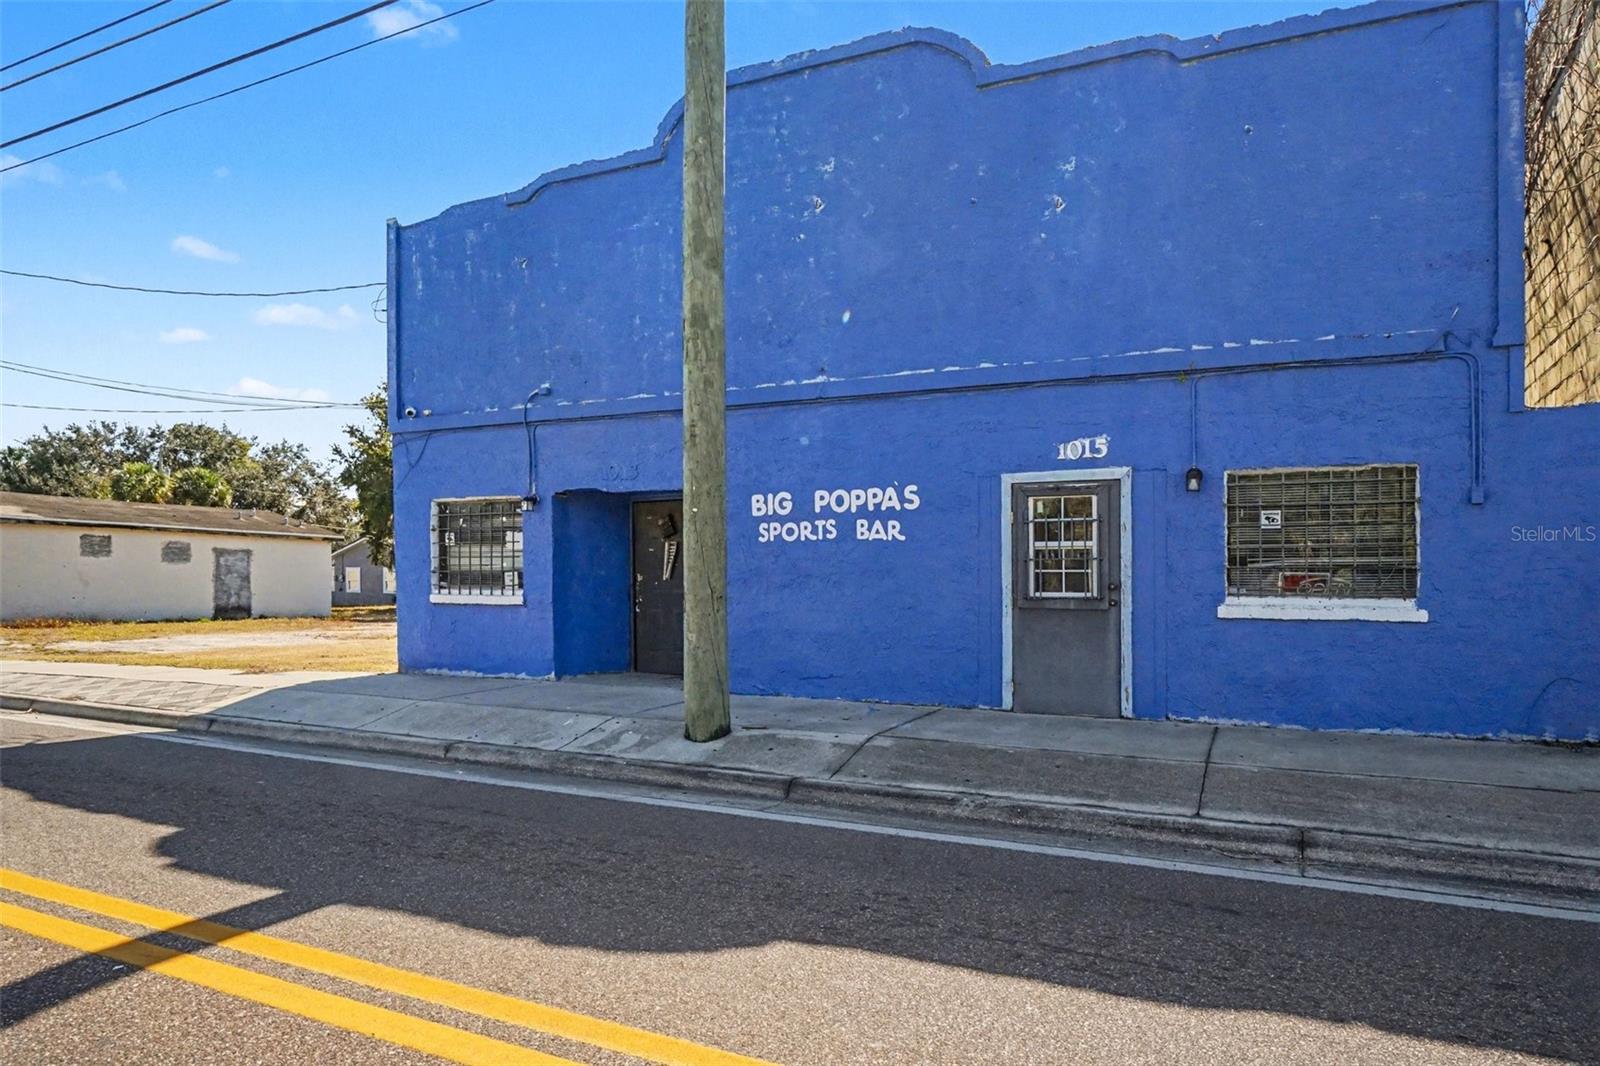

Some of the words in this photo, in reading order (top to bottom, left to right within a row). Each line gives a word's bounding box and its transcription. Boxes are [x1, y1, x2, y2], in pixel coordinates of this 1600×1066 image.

[1057, 434, 1110, 460] 1015
[751, 491, 793, 517] BIG
[758, 518, 838, 543] SPORTS
[856, 518, 906, 541] BAR
